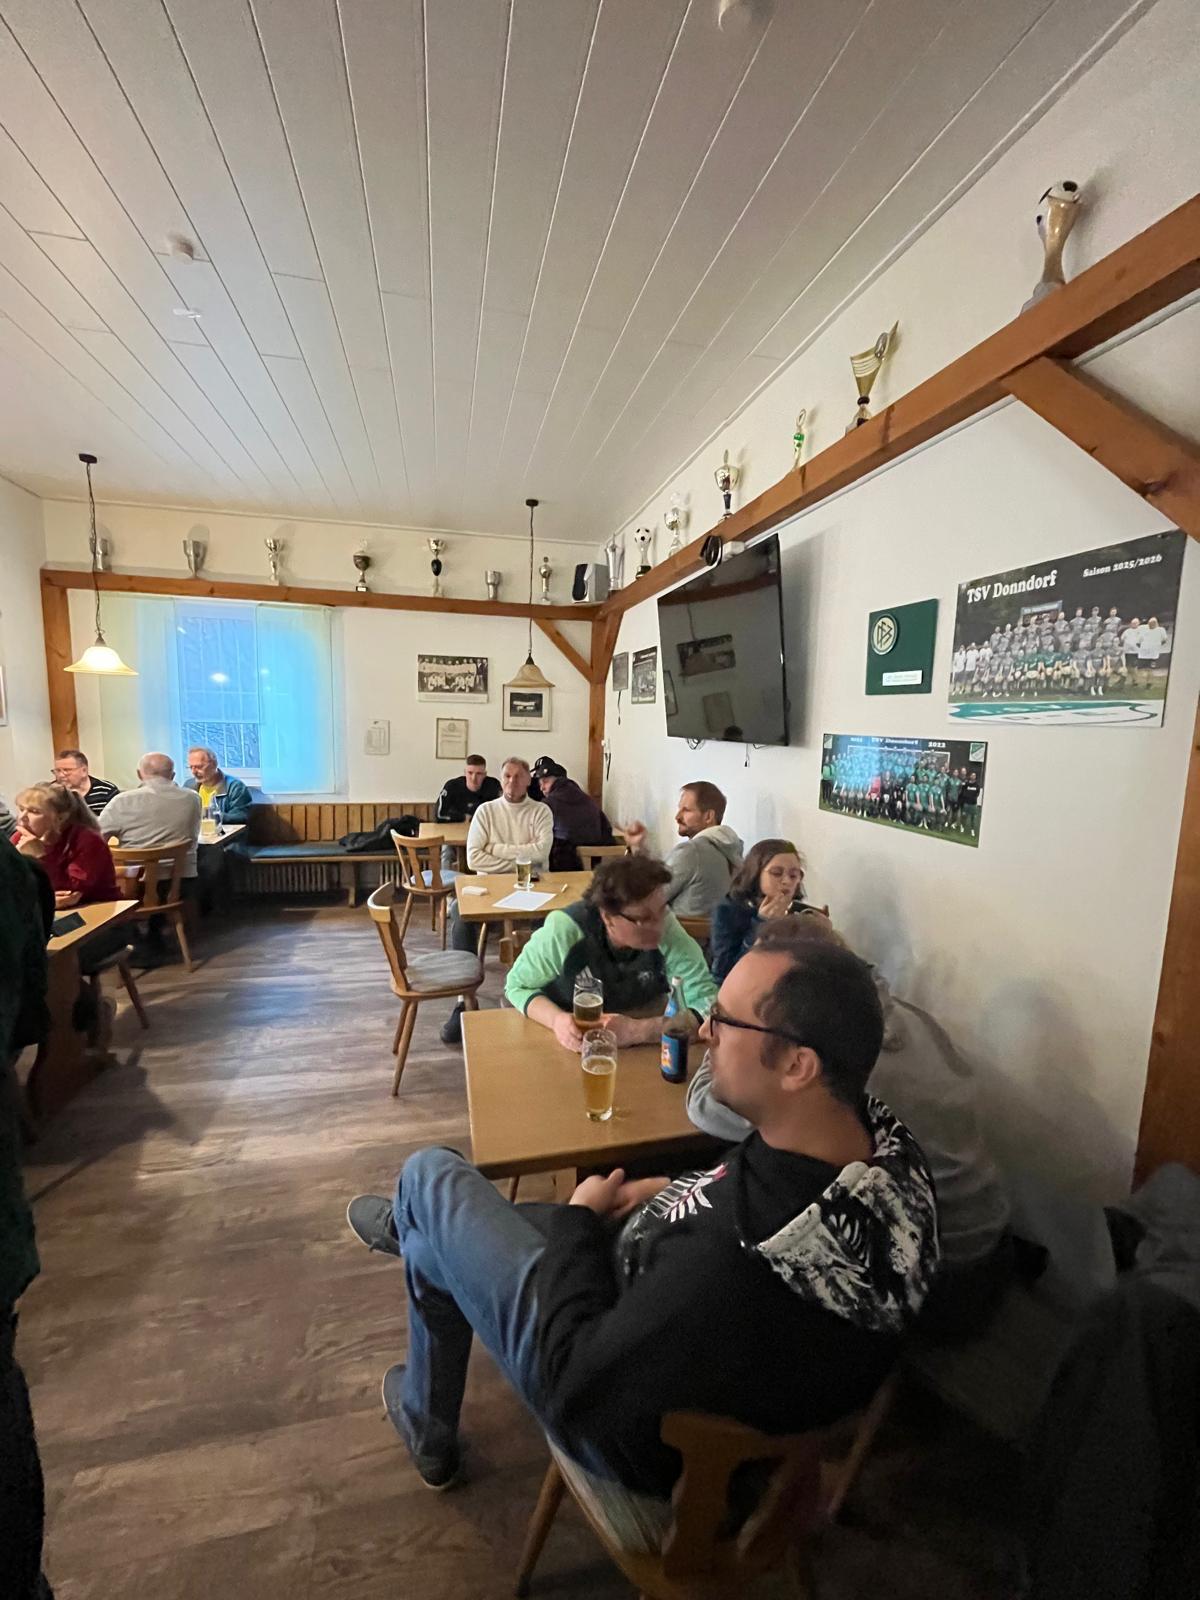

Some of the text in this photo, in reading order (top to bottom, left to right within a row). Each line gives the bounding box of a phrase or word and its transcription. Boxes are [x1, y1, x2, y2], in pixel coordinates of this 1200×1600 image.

[1083, 566, 1111, 577] Saison
[966, 569, 1058, 603] TSV Donndorf
